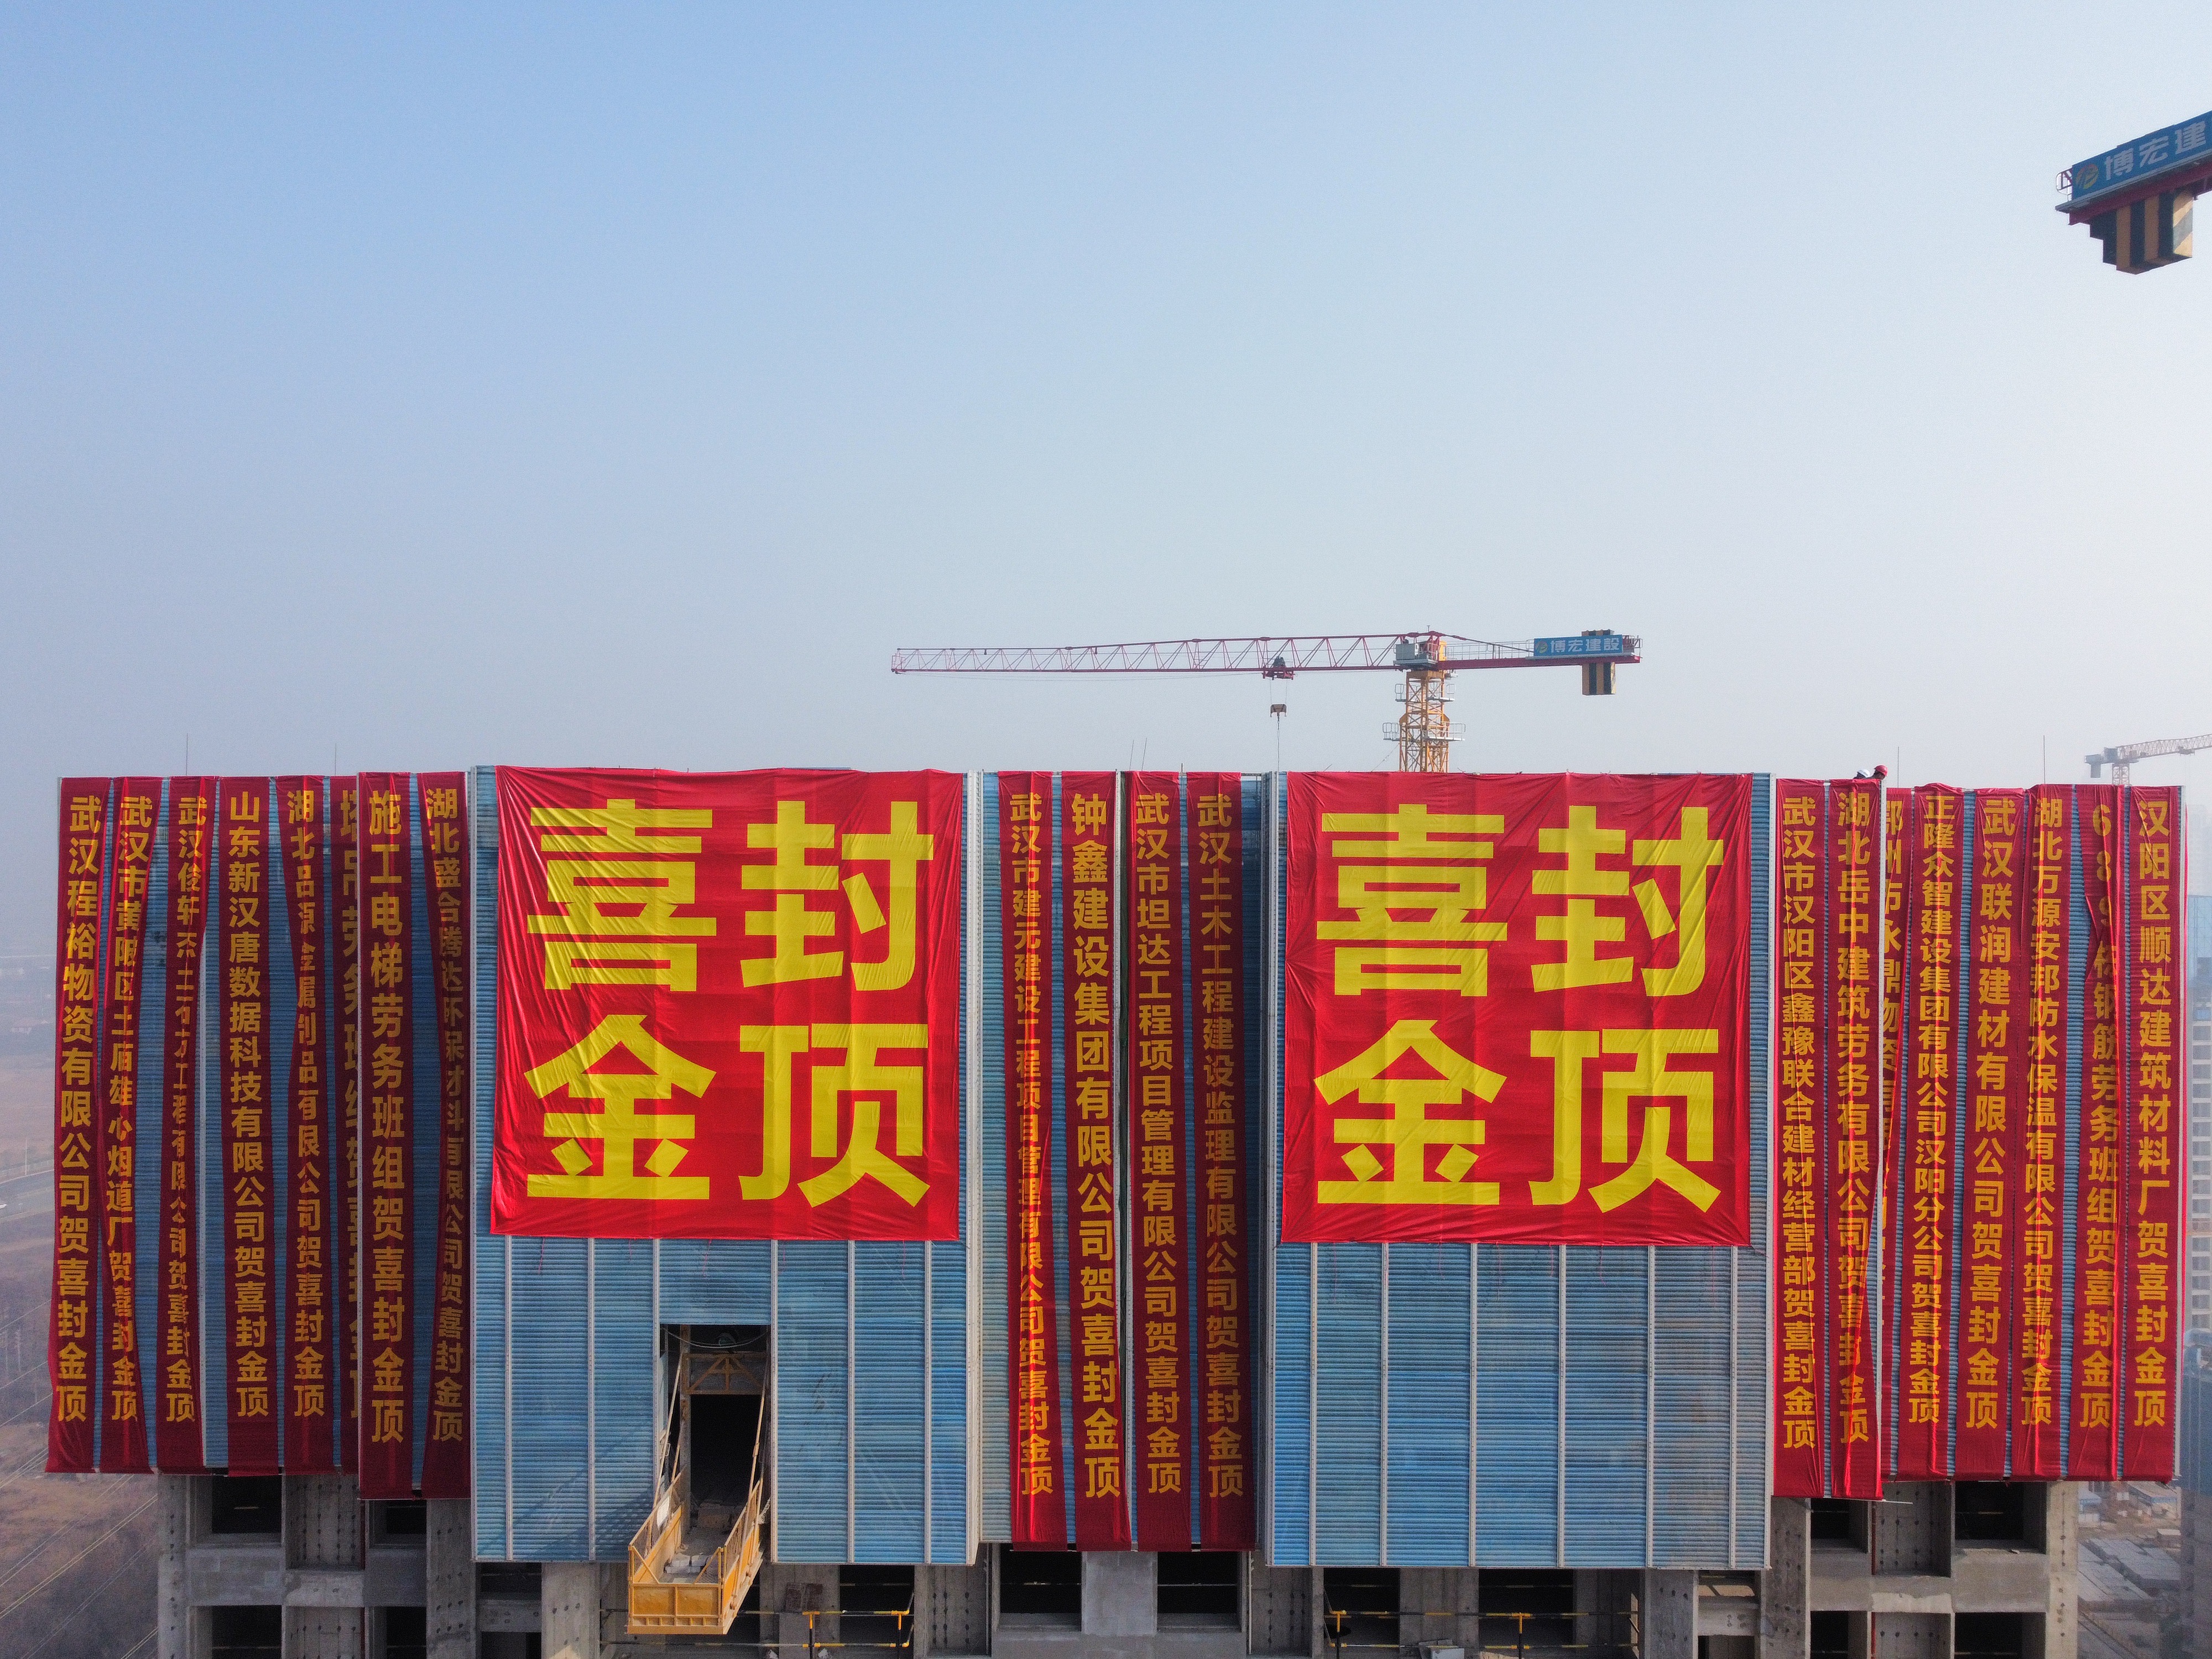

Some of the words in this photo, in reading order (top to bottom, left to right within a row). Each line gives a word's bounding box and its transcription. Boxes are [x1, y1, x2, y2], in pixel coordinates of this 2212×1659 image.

[527, 799, 934, 992] 喜封
[1317, 804, 1724, 997] 喜封
[1550, 638, 1619, 653] 博宏建設
[57, 795, 101, 1421] 武汉程裕物资有限公司贺喜封金顶
[229, 792, 268, 1416] 山东新汉唐数据科技有限公司贺喜封金顶
[369, 791, 404, 1442] 施工电梯劳务班组贺喜封金顶
[524, 1014, 930, 1208] 金顶
[1072, 794, 1120, 1498] 钟鑫建设集团有限公司贺喜封金顶
[1136, 793, 1180, 1493] 武汉市坦达工程项目管理有限公司贺喜封金顶
[1198, 794, 1241, 1497] 武汉土木工程建设监理有限公司贺喜封金顶
[1314, 1020, 1720, 1213] 金顶
[1782, 796, 1815, 1448] 武汉市汉阳区鑫豫联合建材经营部贺喜封金顶
[1838, 792, 1870, 1443] 湖北岳中建筑劳务有限公司贺喜封金顶
[1909, 796, 1955, 1423] 正隆众智建设集团有限公司汉阳分公司贺喜封金顶
[1966, 798, 2016, 1428] 武汉联润建材有限公司贺喜封金顶
[2022, 797, 2062, 1425] 湖北万源安邦防水保温有限公司贺喜封金顶
[2135, 801, 2172, 1426] 汉阳区顺达建筑材料厂贺喜封金顶
